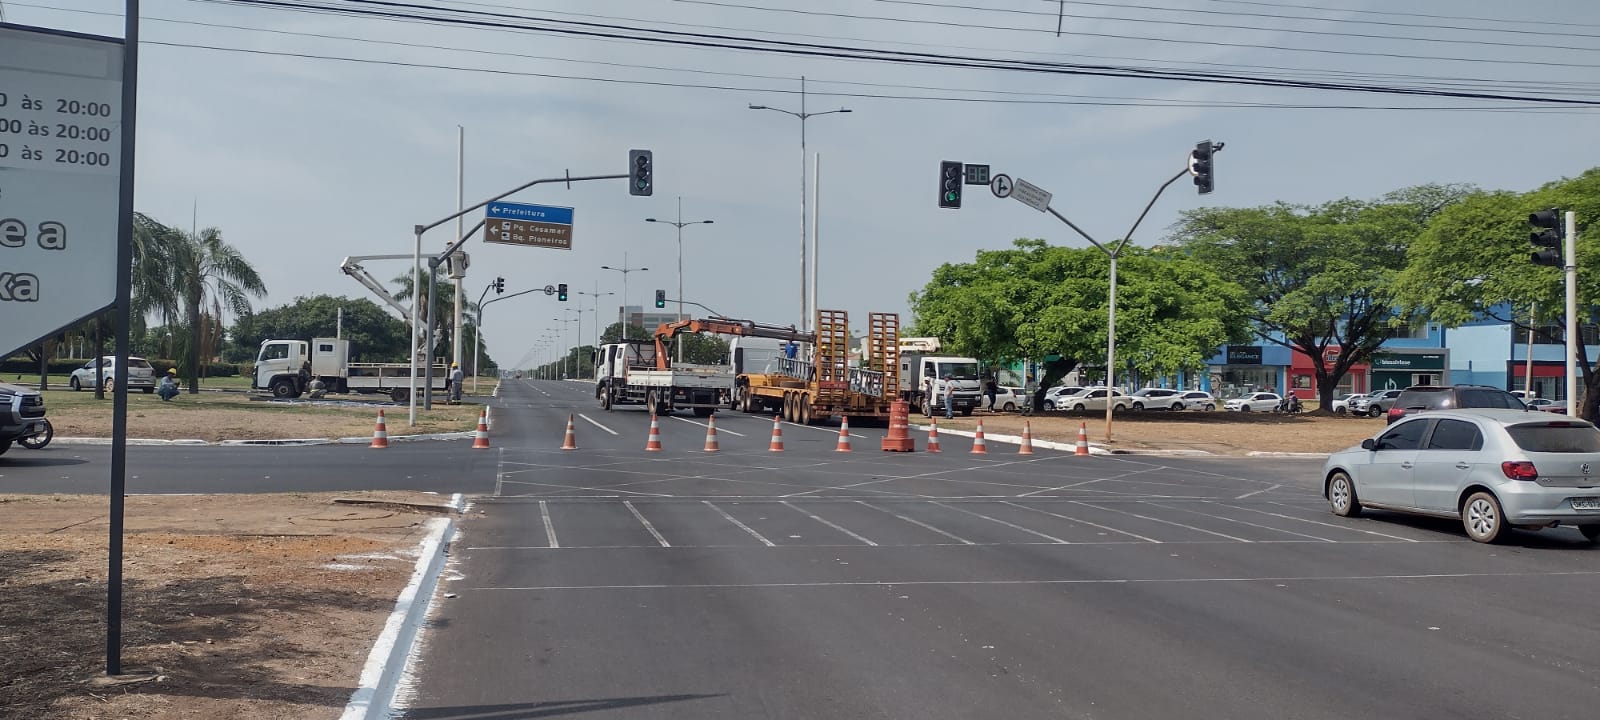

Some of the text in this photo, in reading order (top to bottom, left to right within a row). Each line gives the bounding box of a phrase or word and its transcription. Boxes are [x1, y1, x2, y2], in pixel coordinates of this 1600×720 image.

[21, 94, 43, 111] às
[56, 98, 111, 117] 20:00
[28, 120, 49, 136] às
[55, 123, 110, 142] 20:00
[21, 145, 43, 160] às
[55, 149, 110, 166] 20:00
[502, 207, 545, 218] Prefeitura
[37, 221, 66, 250] a
[528, 235, 567, 245] Pioneiros
